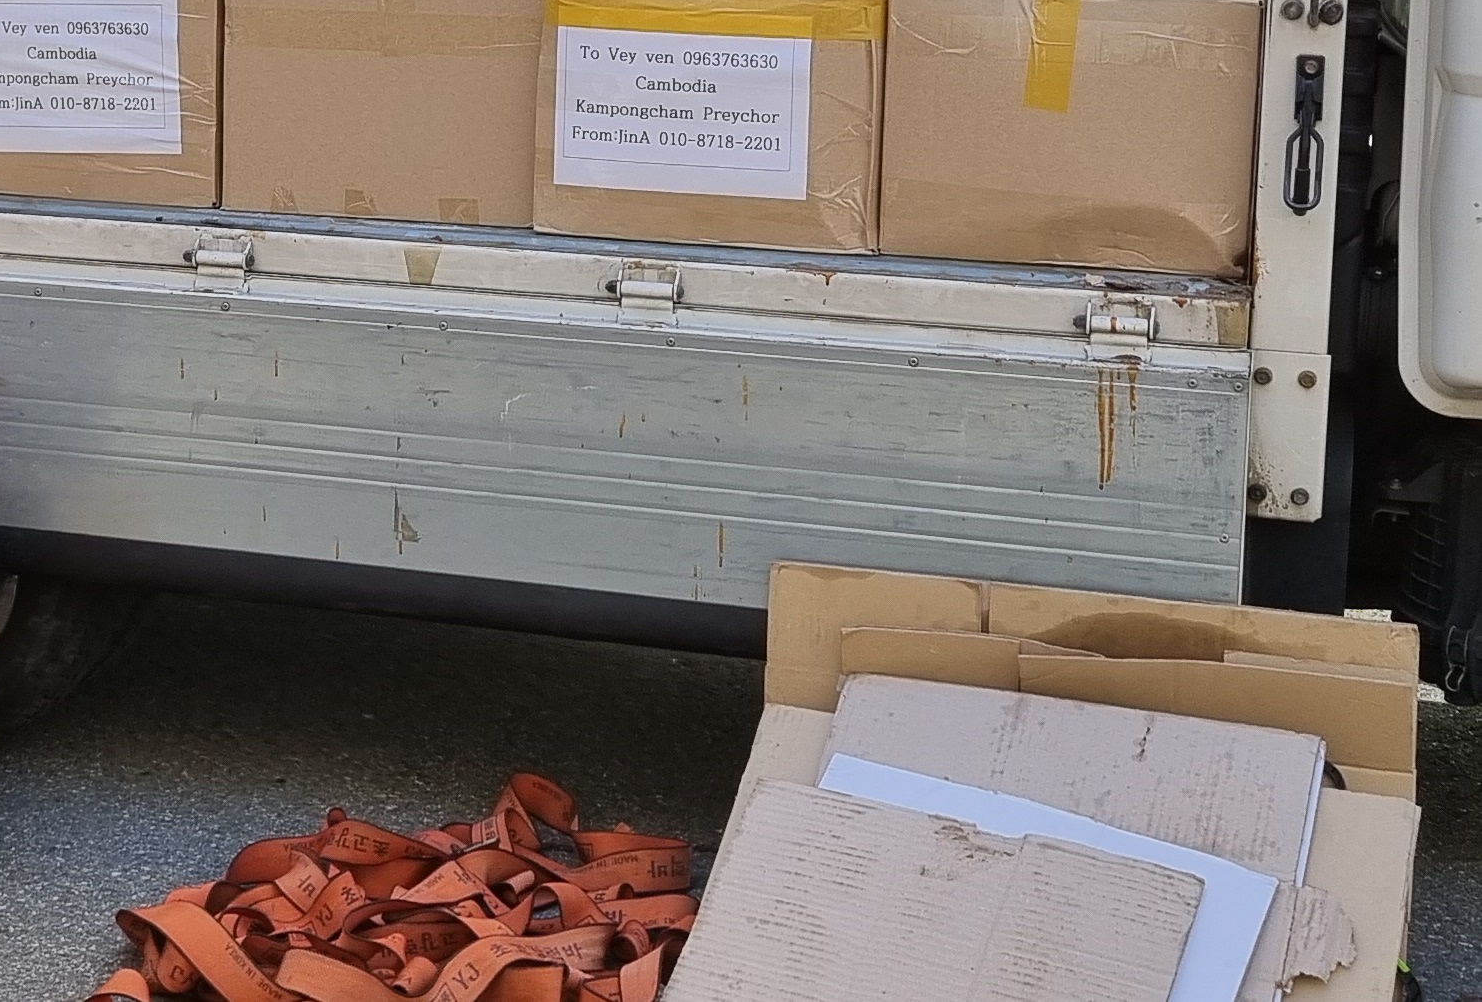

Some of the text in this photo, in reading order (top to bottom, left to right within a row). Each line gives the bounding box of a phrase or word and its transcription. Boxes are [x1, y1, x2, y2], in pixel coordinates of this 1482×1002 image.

[1, 21, 27, 36] Vey
[35, 25, 59, 35] ven
[67, 21, 149, 36] 0963763630
[27, 46, 98, 60] Cambodia
[579, 45, 778, 69] To Vey ven 0963763630
[86, 72, 154, 88] Preychor
[635, 75, 717, 94] Cambodia
[50, 96, 157, 111] 010-8718-2201
[575, 98, 780, 125] Kampongcham Preychor
[571, 125, 782, 152] From:JinA 010-8718-2201
[452, 962, 481, 991] YJ
